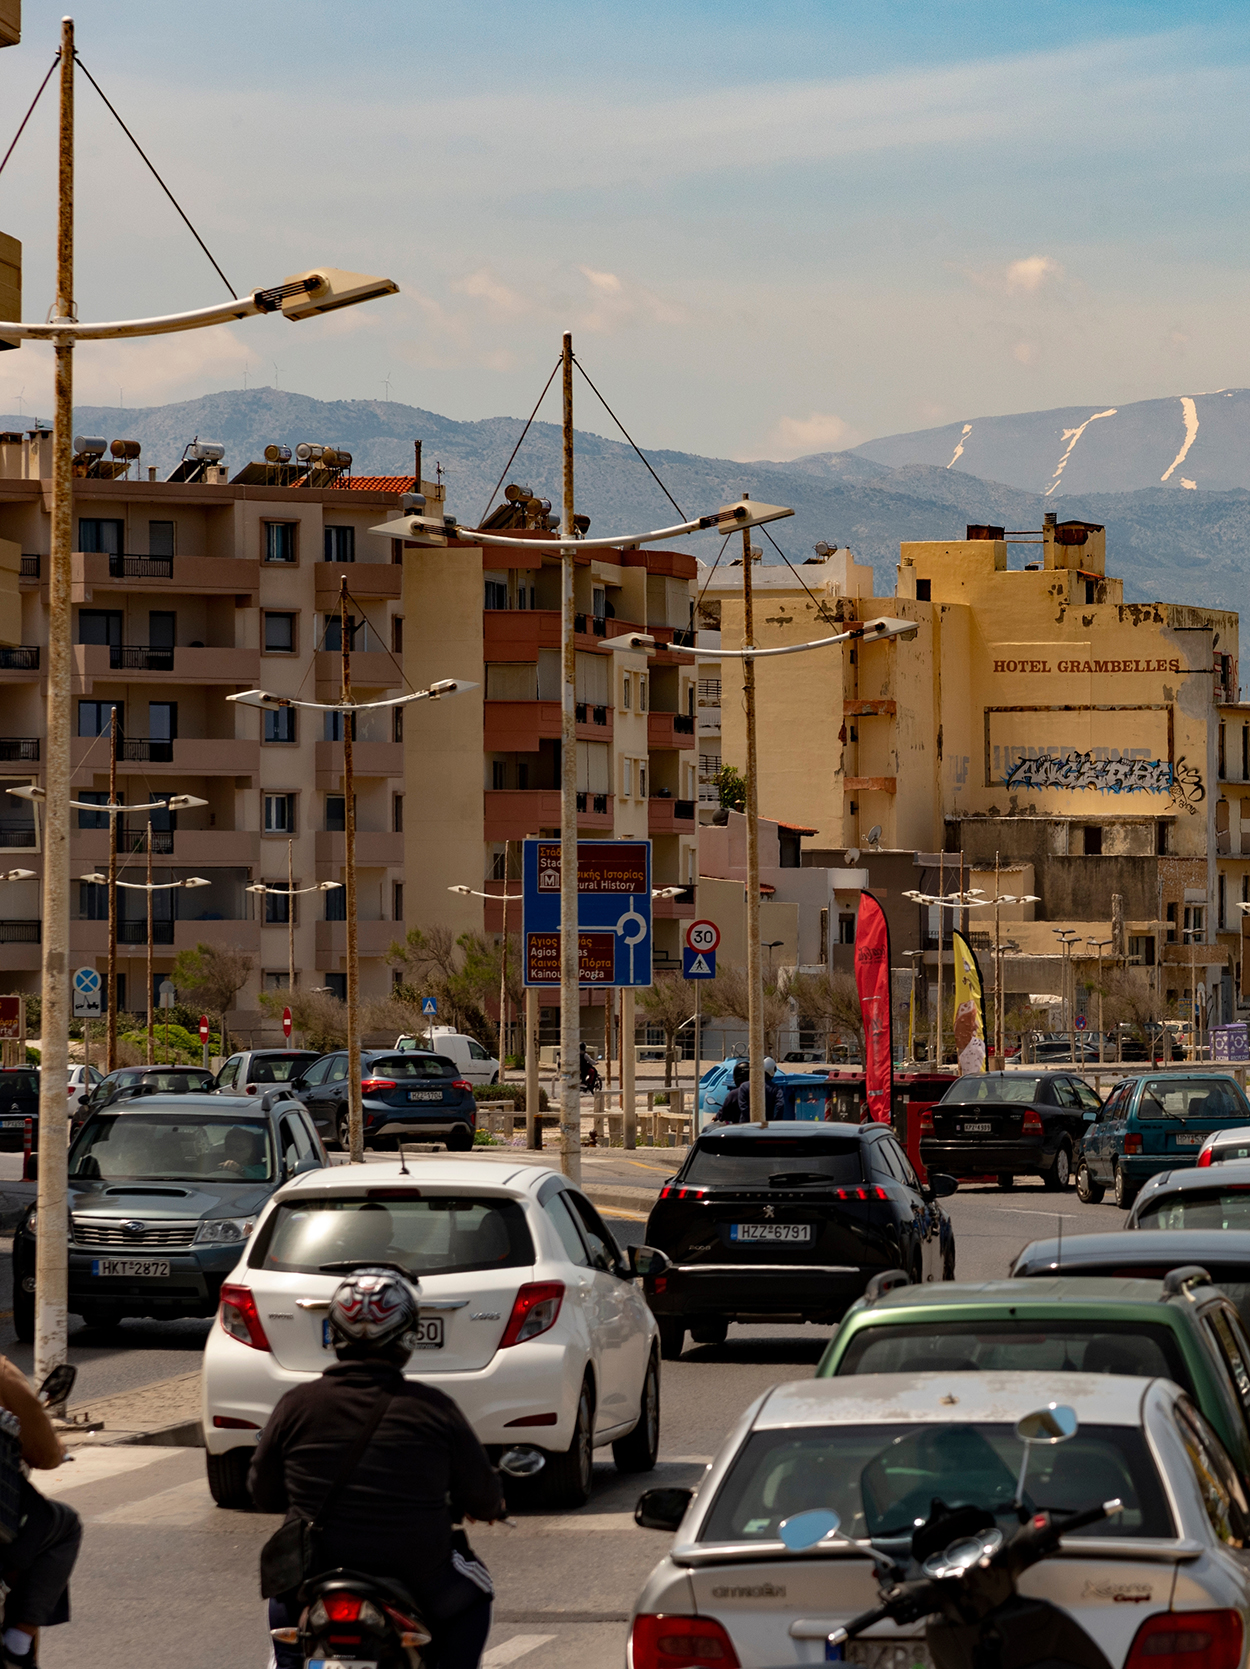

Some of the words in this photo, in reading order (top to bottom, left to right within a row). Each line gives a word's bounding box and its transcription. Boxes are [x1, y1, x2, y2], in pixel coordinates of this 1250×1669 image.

[993, 660, 1051, 672] HOTEL
[1057, 659, 1180, 672] GRAMBELLES
[603, 869, 644, 881] Ιστορίας
[601, 880, 635, 892] History
[693, 930, 713, 944] 30
[530, 947, 557, 958] Agios
[581, 958, 611, 969] Πόρτα
[741, 1225, 808, 1239] HZZ-6791
[102, 1261, 169, 1276] HKT-2872
[469, 1312, 501, 1321] YARIS
[712, 1582, 787, 1598] CITROËN
